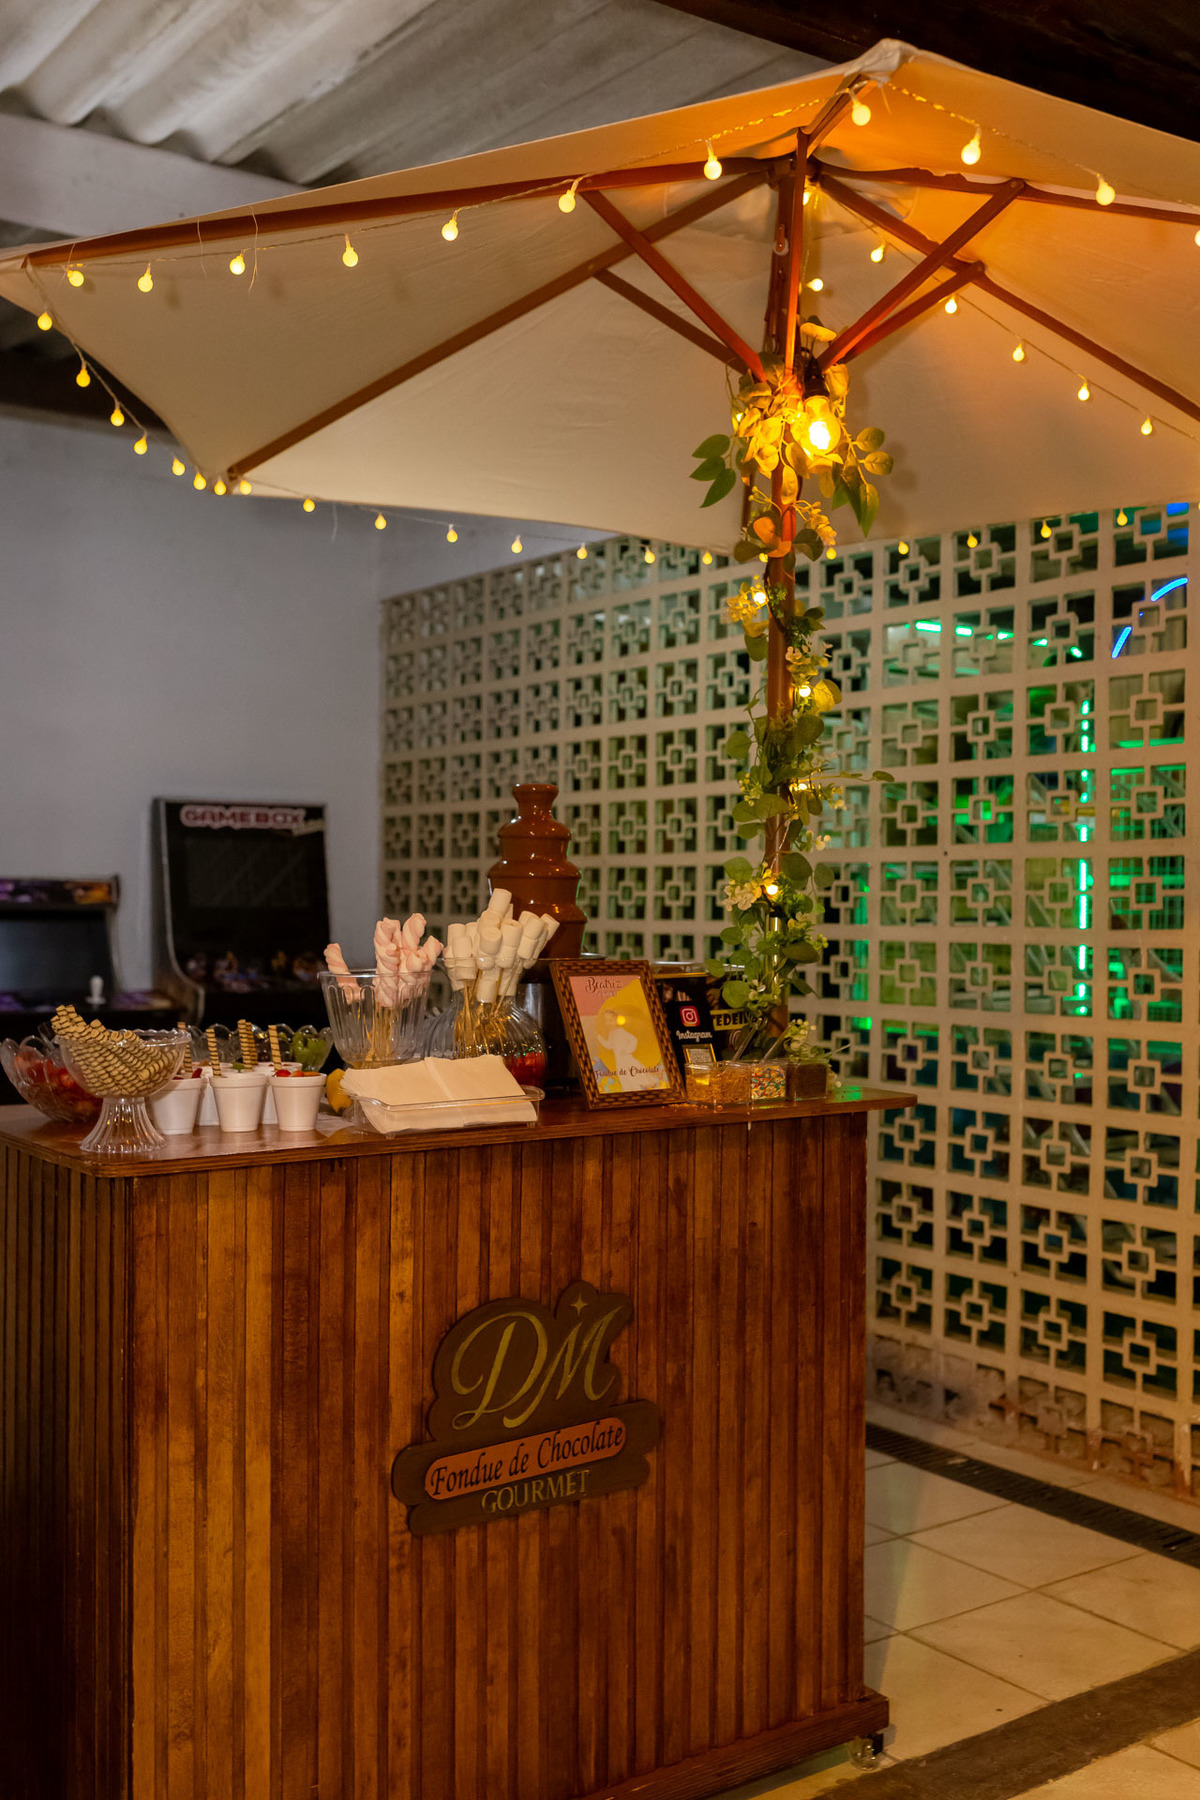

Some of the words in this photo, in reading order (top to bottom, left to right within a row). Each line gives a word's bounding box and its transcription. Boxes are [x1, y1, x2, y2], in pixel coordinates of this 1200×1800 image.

[583, 976, 623, 994] Beatriz
[676, 1030, 713, 1043] Instagram
[619, 1068, 627, 1076] de
[451, 1306, 625, 1430] DM
[430, 1452, 503, 1496] Fondue
[508, 1442, 530, 1477] de
[537, 1421, 624, 1469] Chocolate
[481, 1468, 591, 1514] GOURMET
